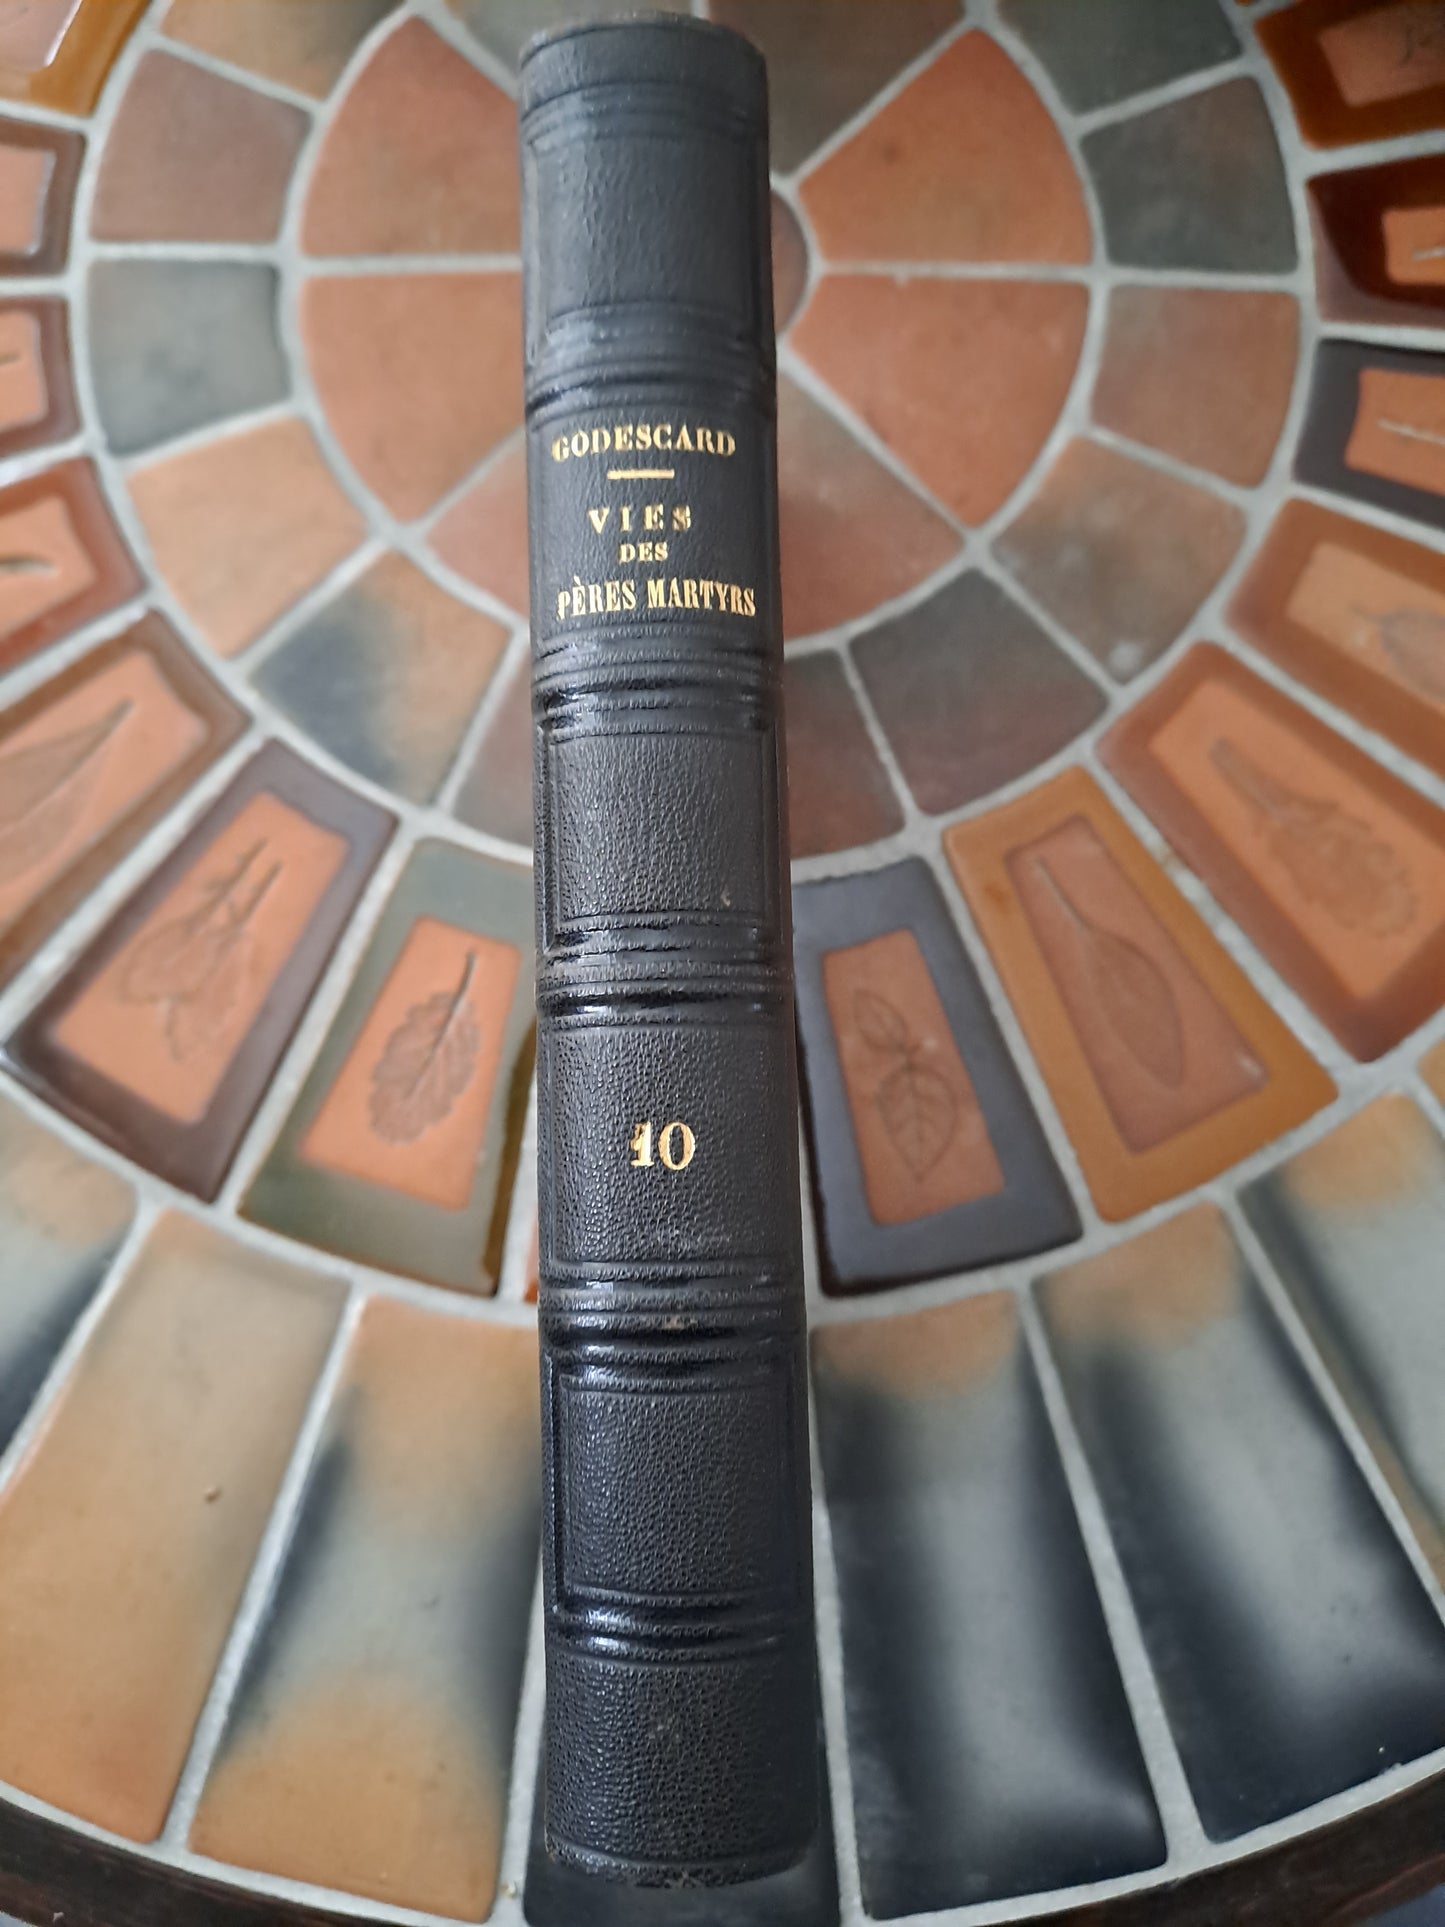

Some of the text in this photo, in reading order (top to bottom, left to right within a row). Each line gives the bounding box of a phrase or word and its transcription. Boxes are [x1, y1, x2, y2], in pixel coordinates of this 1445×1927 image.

[552, 424, 736, 462] GODESCARD
[588, 504, 692, 534] VIES
[619, 542, 669, 563] DES
[556, 576, 756, 621] PÈRES MARTYRS
[630, 1121, 696, 1171] 10
